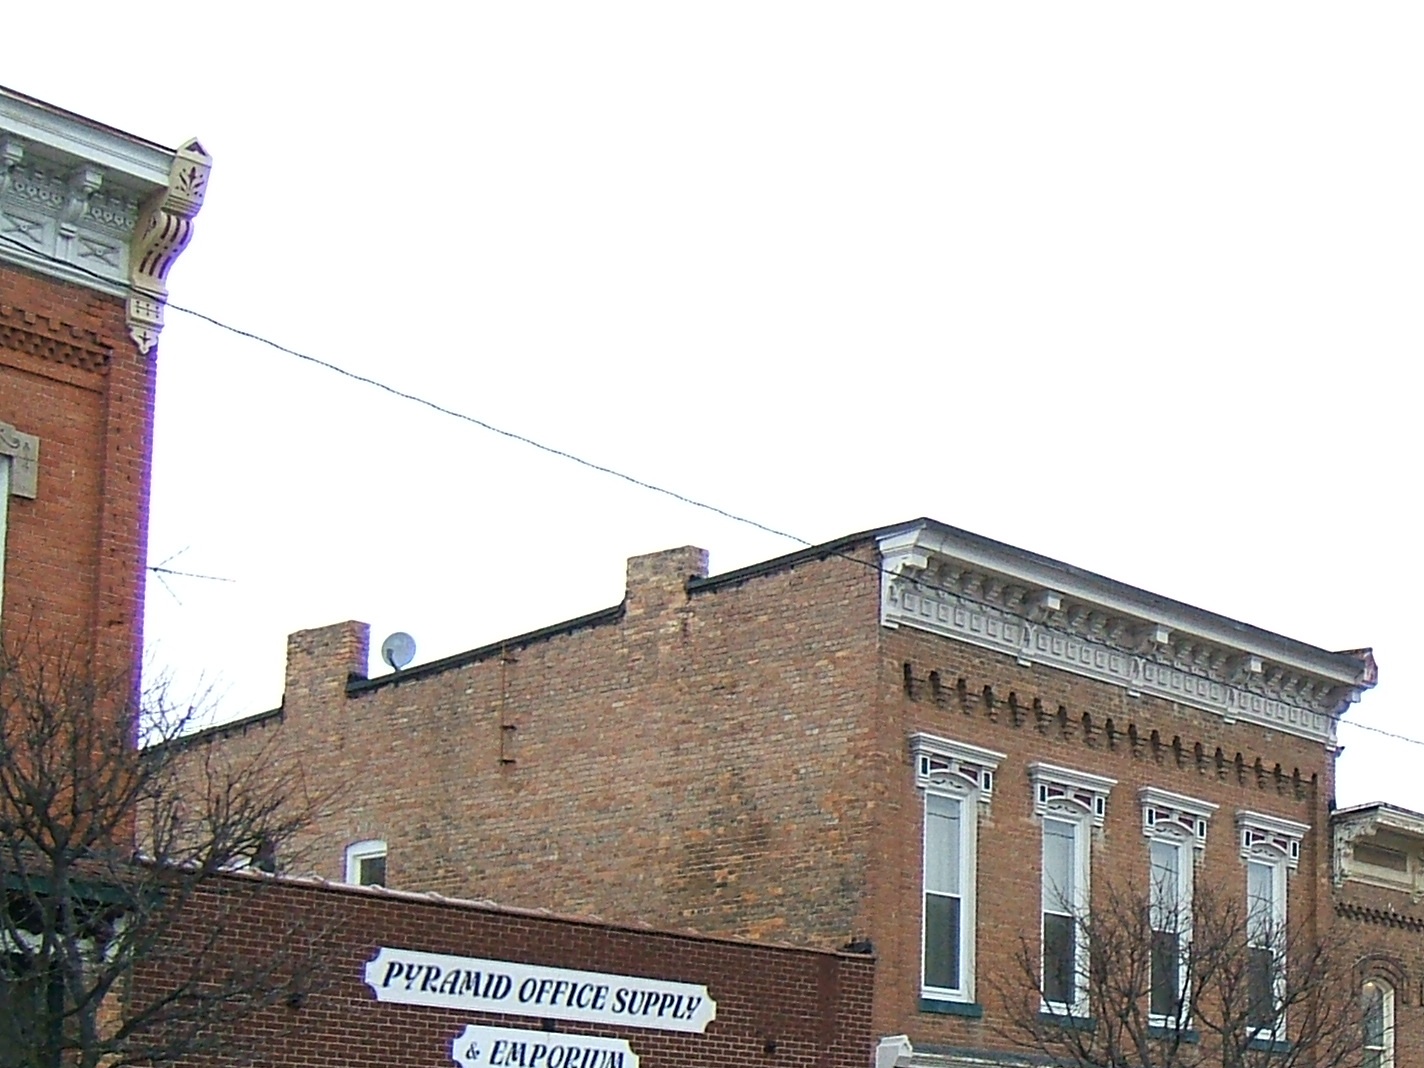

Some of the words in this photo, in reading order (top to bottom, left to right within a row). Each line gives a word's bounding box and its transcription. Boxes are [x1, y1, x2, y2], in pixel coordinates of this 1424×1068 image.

[383, 961, 513, 1000] PYRAMID
[518, 978, 608, 1011] OFFICE
[612, 988, 702, 1021] SUPPLY
[466, 1041, 481, 1060] &
